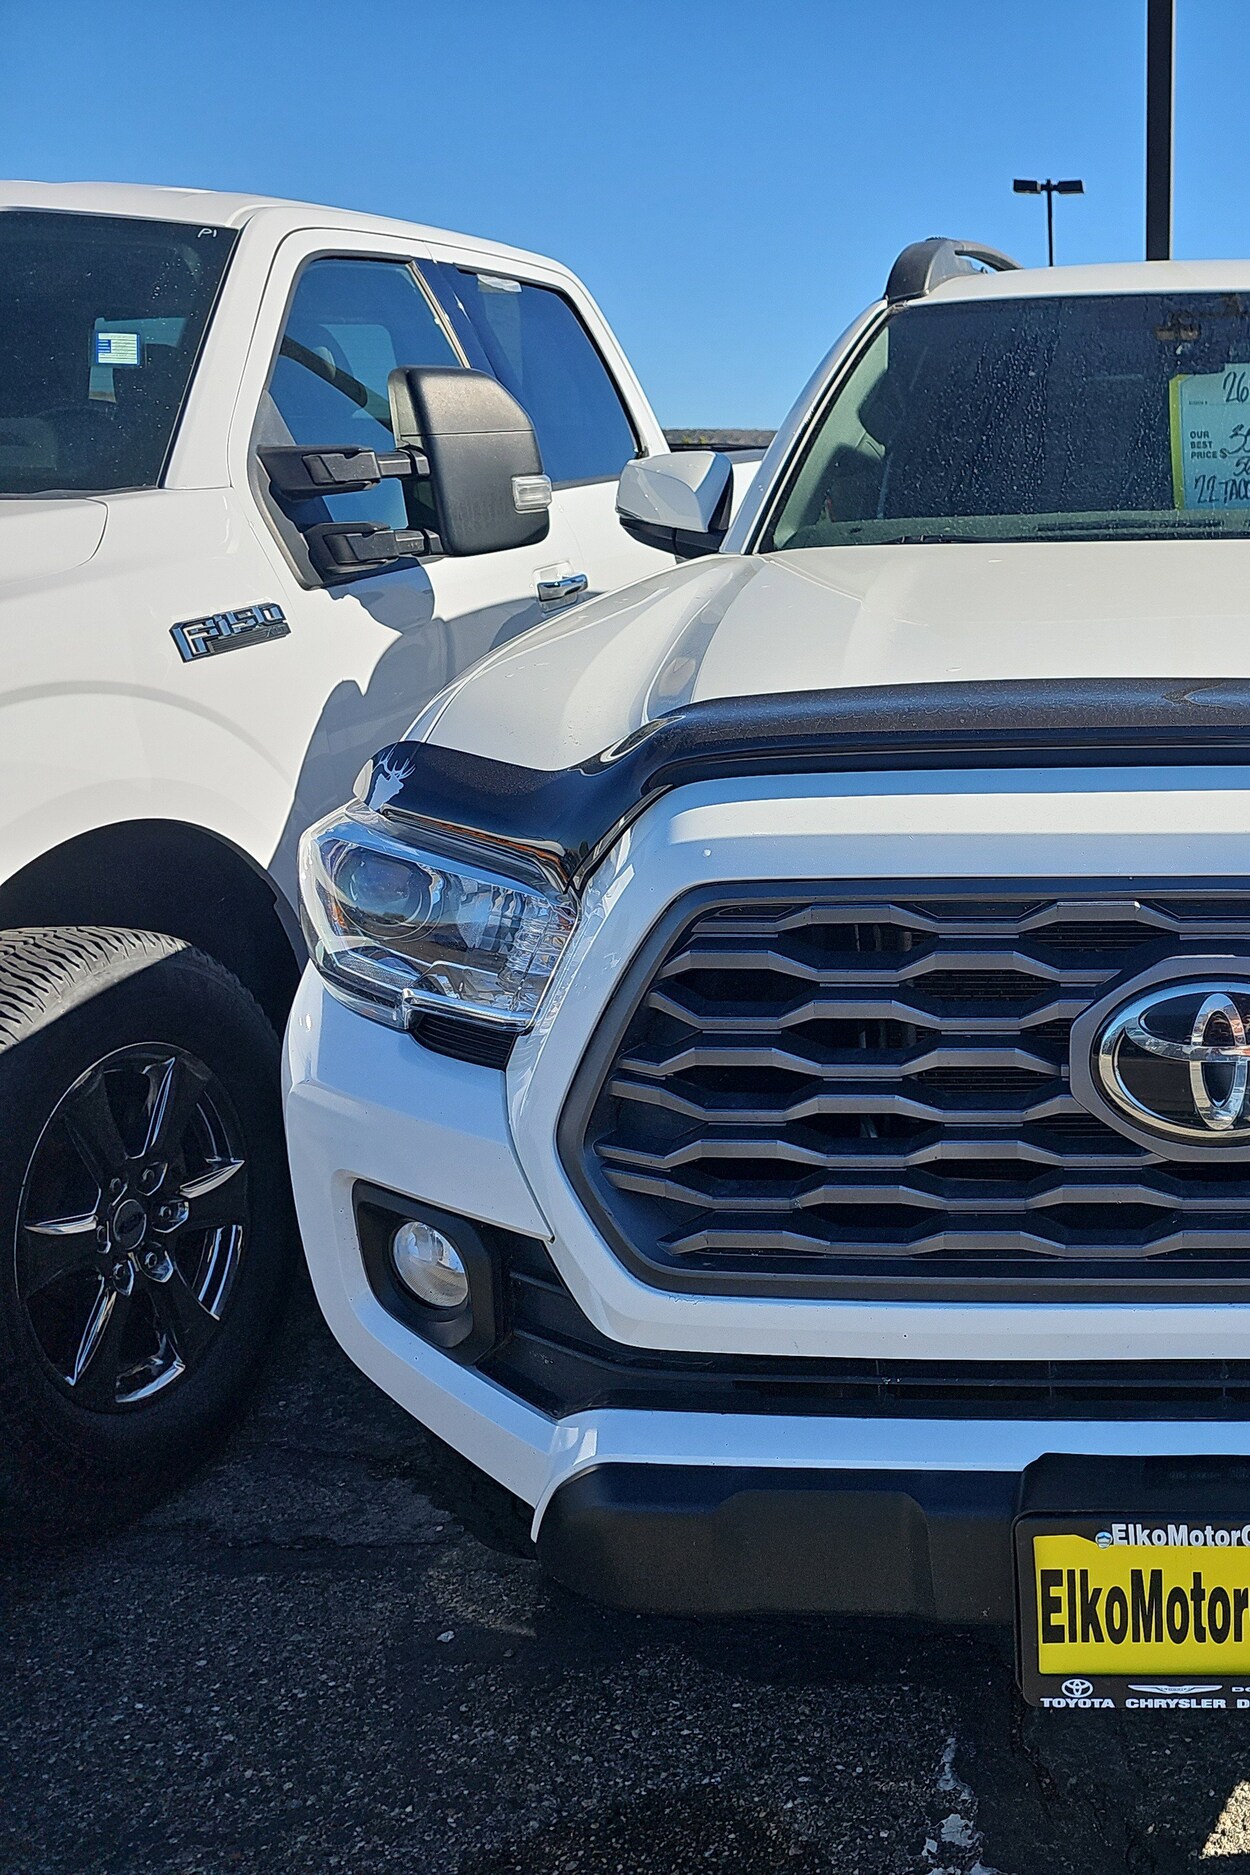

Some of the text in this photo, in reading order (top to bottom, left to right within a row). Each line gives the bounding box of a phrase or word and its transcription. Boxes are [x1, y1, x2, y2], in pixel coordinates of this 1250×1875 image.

[1189, 430, 1210, 440] OUR
[1190, 440, 1213, 449] BEST
[1190, 450, 1217, 459] PRICE
[1194, 474, 1217, 504] 22
[1040, 1698, 1116, 1709] TOYOTA
[1125, 1698, 1226, 1709] CHRYSLER
